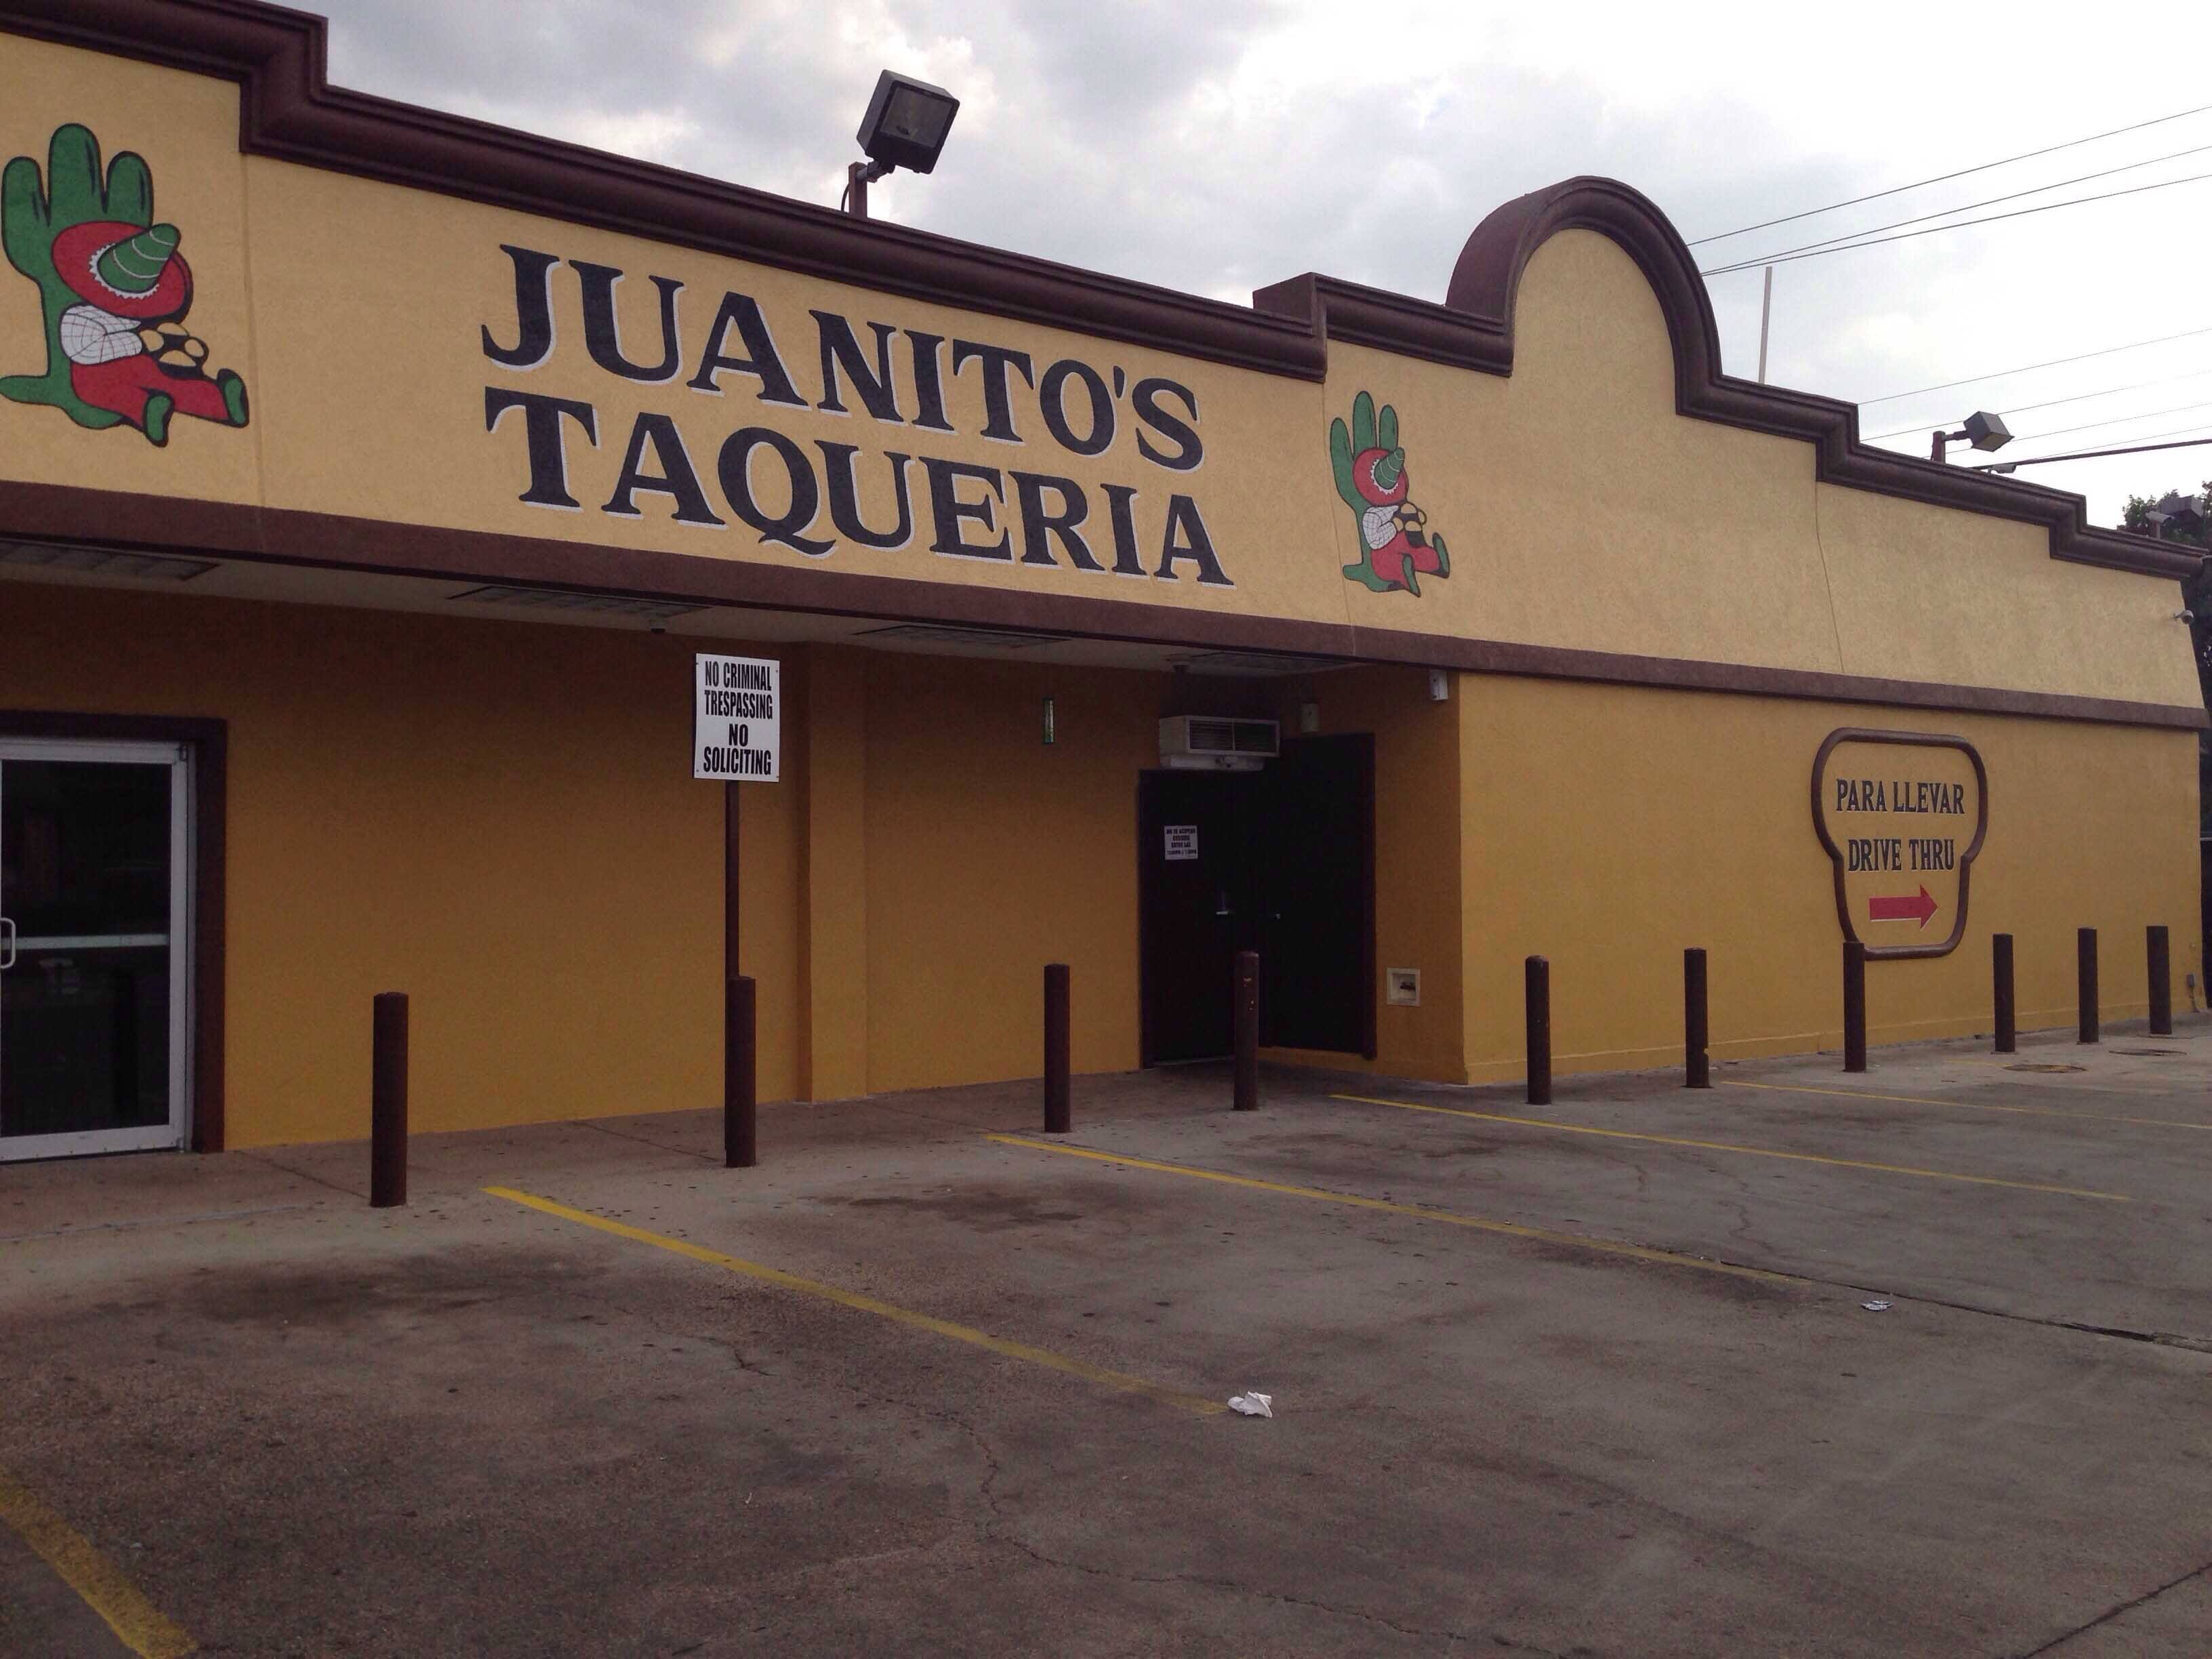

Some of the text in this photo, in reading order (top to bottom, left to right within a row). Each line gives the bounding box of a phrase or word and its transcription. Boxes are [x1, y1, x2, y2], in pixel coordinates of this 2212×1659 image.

[482, 243, 1204, 472] JUANITO'S
[485, 386, 1236, 589] TAQUERIA
[705, 661, 771, 691] NO CRIMINAL
[705, 689, 773, 719] TRESPASSING
[729, 723, 748, 746] NO
[703, 746, 771, 775] SOLICITING
[1836, 779, 1965, 815] PARA LLEVAR
[1848, 838, 1954, 872] DRIVE THRU
